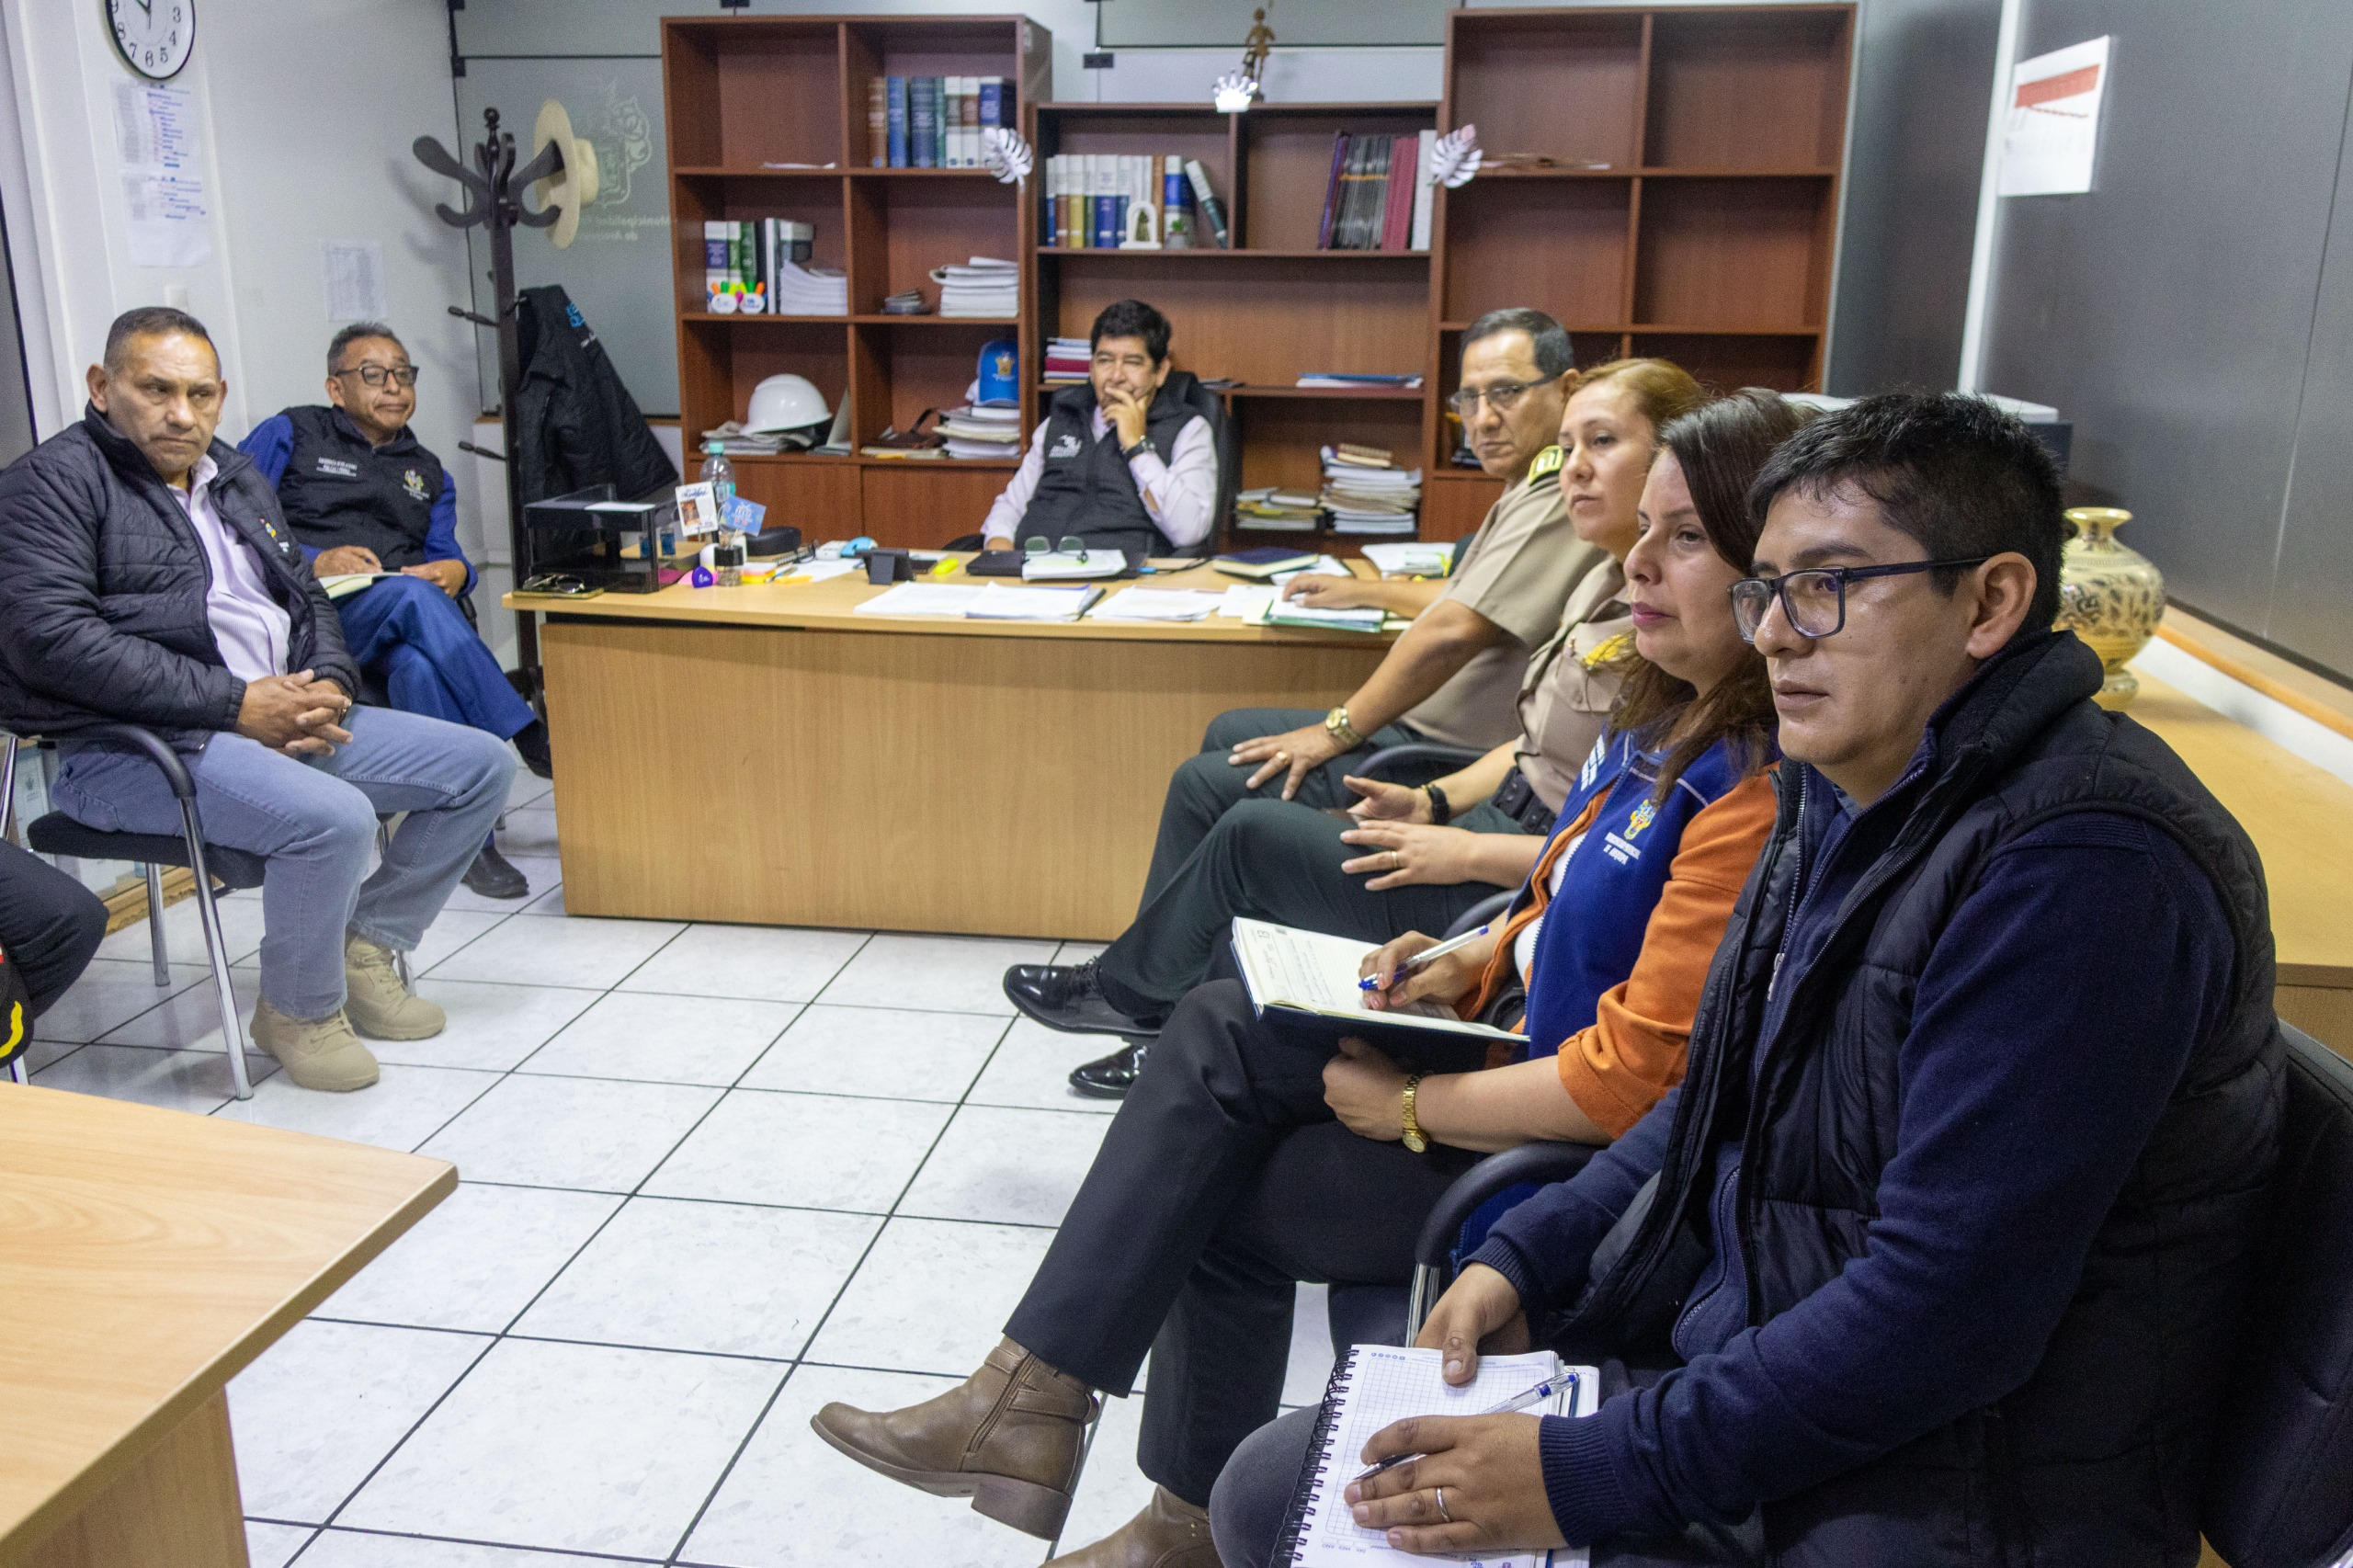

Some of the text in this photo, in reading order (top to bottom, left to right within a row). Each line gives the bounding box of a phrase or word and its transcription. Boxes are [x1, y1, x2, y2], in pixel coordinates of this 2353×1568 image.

[173, 6, 181, 23] 3
[117, 21, 126, 40] 8
[169, 29, 176, 46] 4
[130, 42, 137, 59] 7
[145, 50, 153, 67] 6
[160, 46, 168, 63] 5
[1256, 929, 1270, 939] 13
